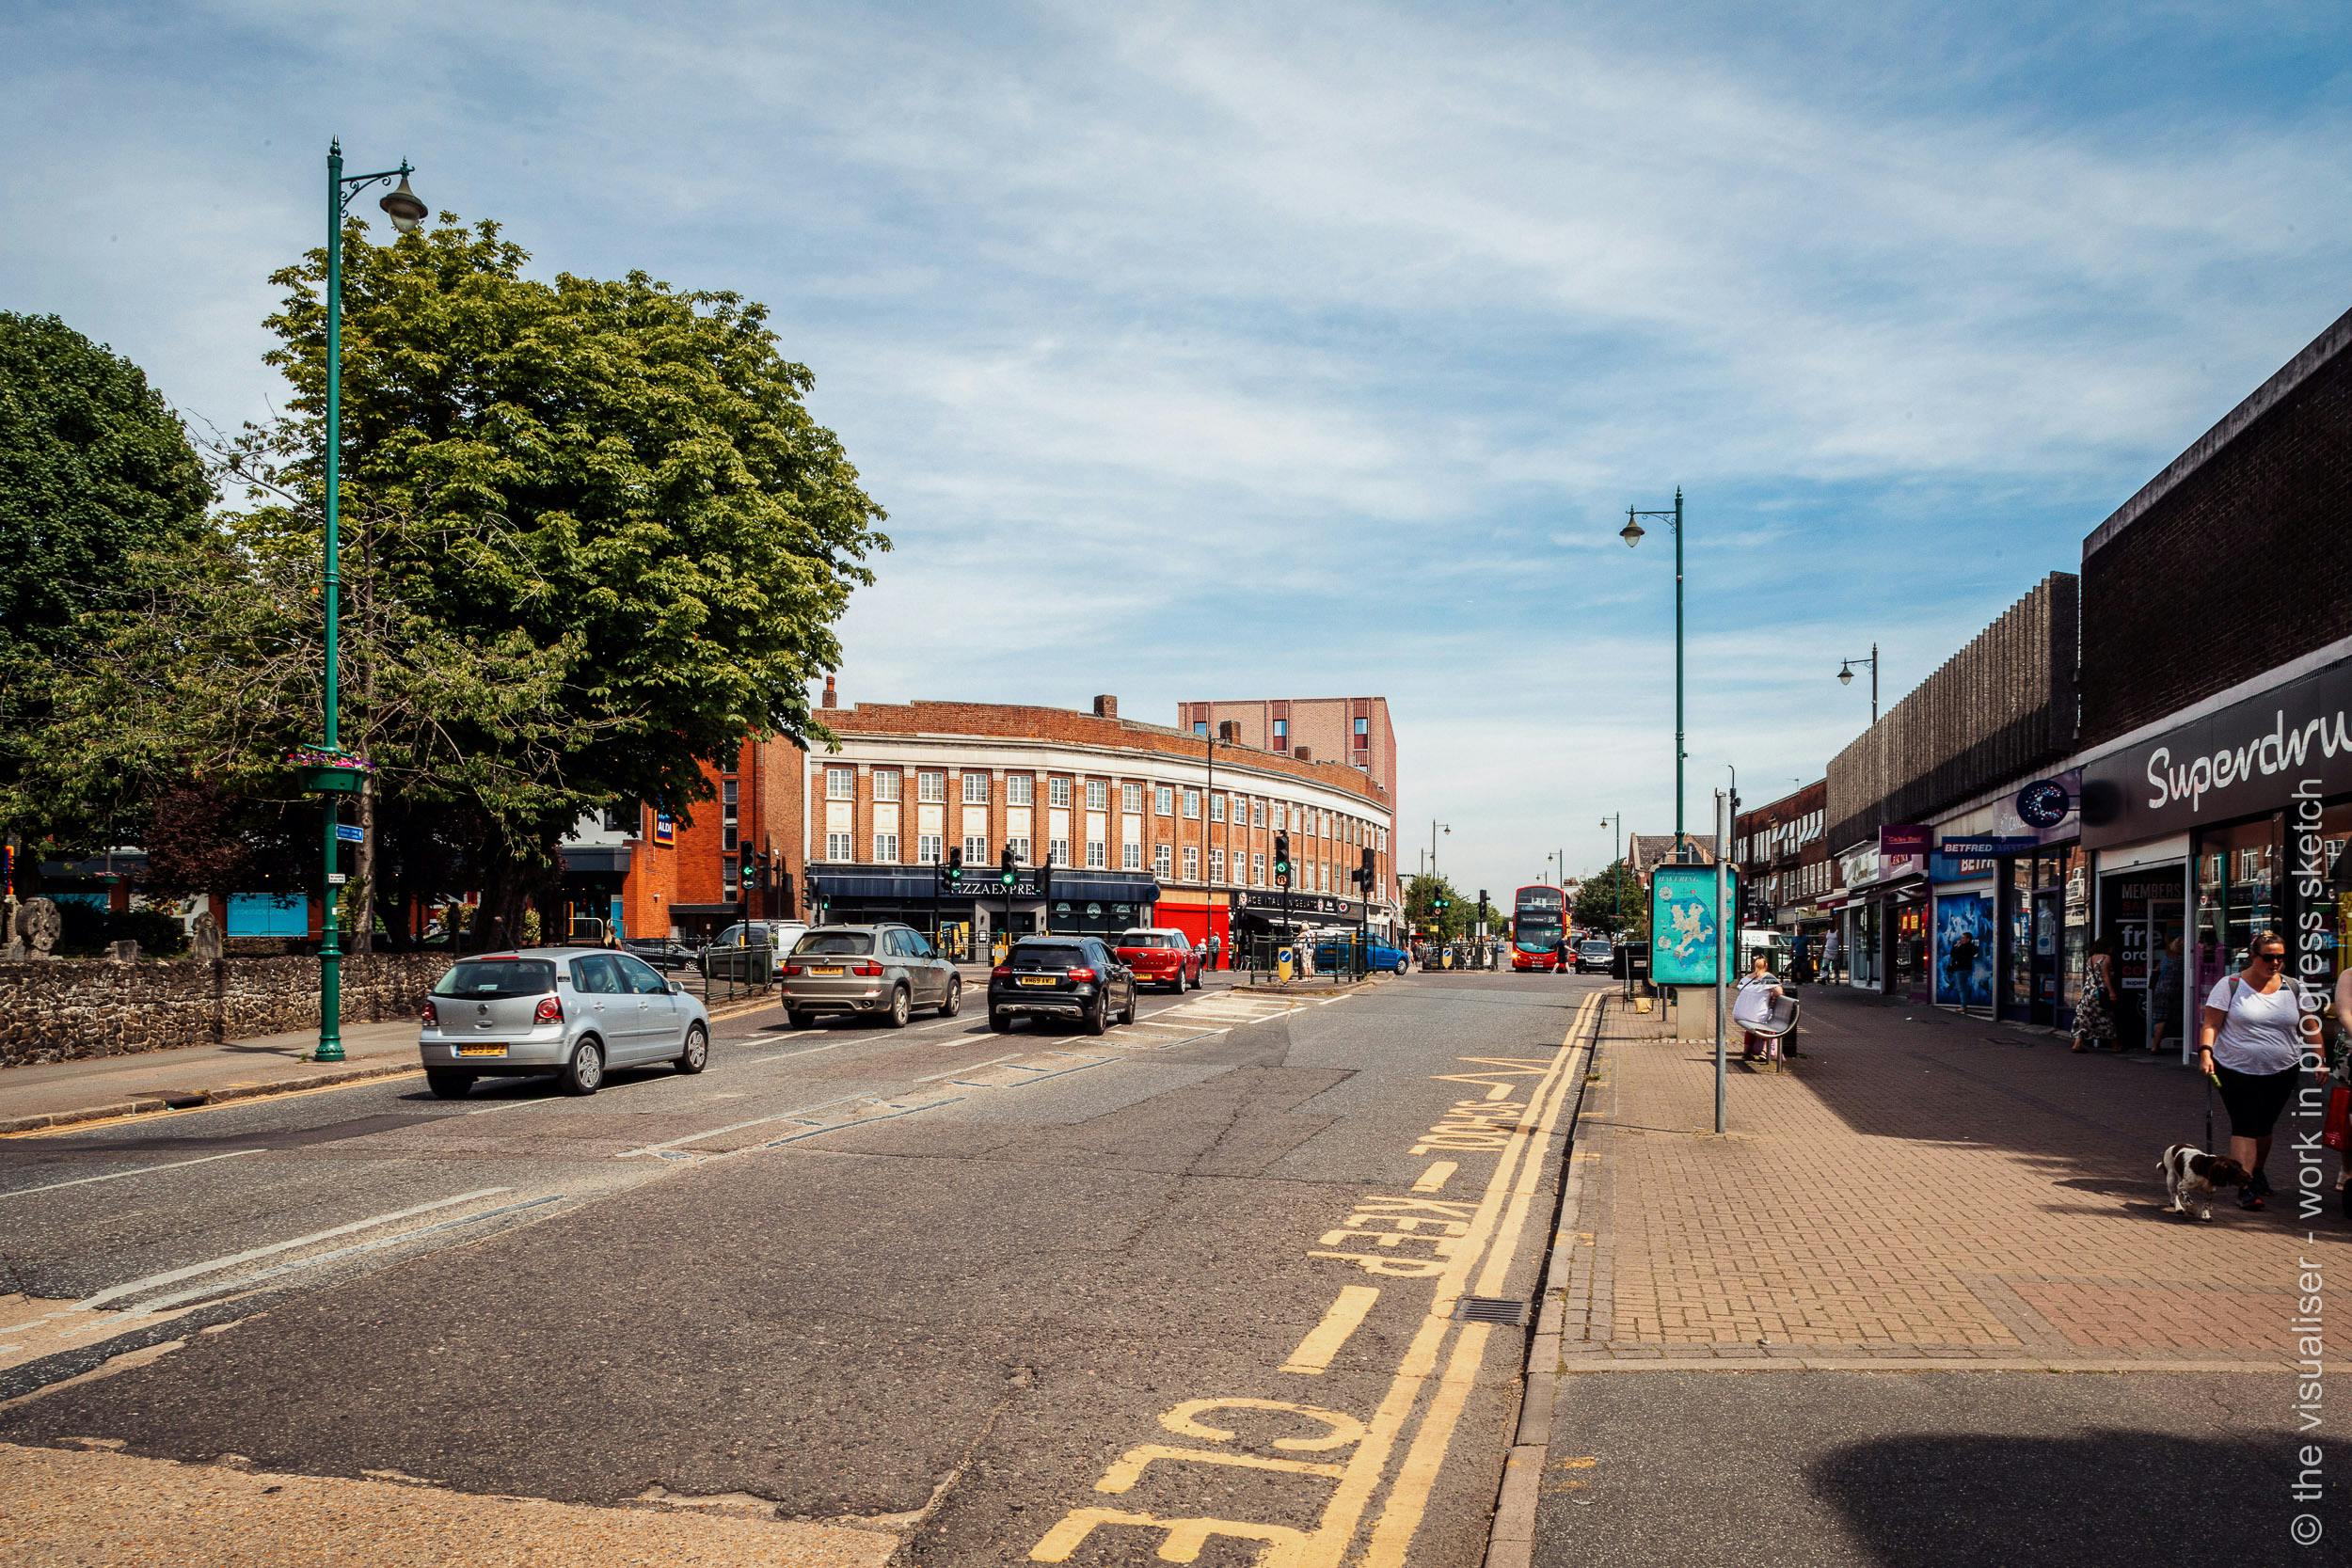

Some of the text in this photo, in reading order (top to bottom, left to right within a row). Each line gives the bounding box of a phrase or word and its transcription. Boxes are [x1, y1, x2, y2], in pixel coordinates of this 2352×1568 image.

[658, 821, 673, 834] ALDI
[1944, 843, 1993, 852] BETFRED
[2122, 883, 2181, 899] MEMBERS
[1307, 1196, 1480, 1277] KEEP
